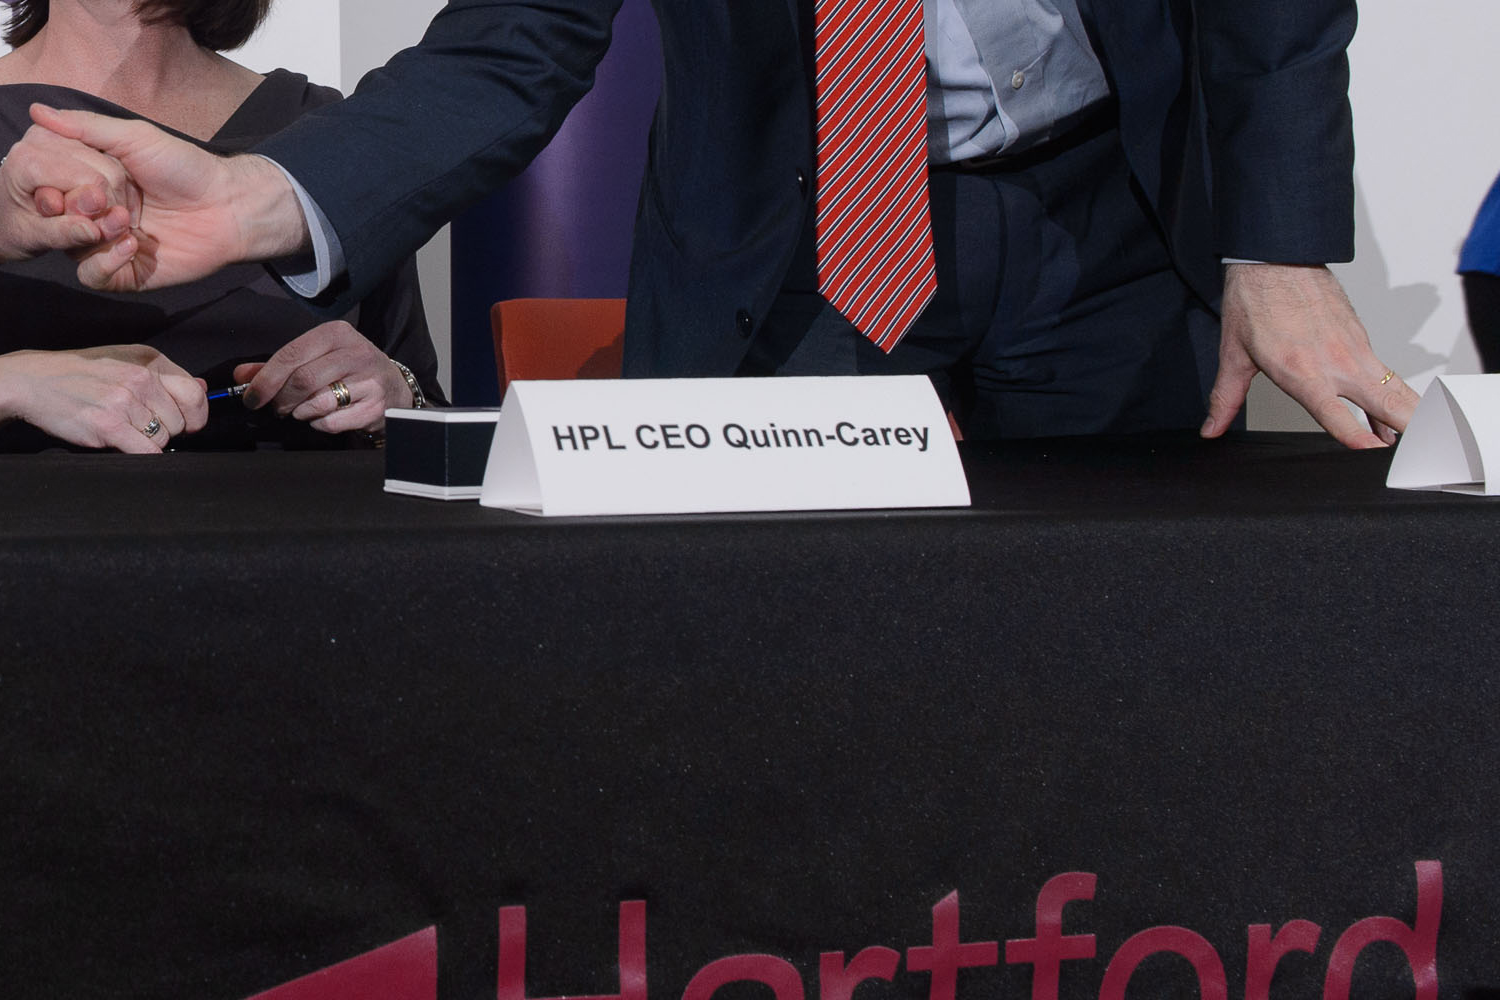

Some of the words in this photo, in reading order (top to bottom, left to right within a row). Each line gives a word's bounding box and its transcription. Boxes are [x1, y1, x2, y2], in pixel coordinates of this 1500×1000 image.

[551, 424, 627, 452] HPL
[635, 423, 712, 450] CEO
[721, 420, 930, 453] Quinn-Carey
